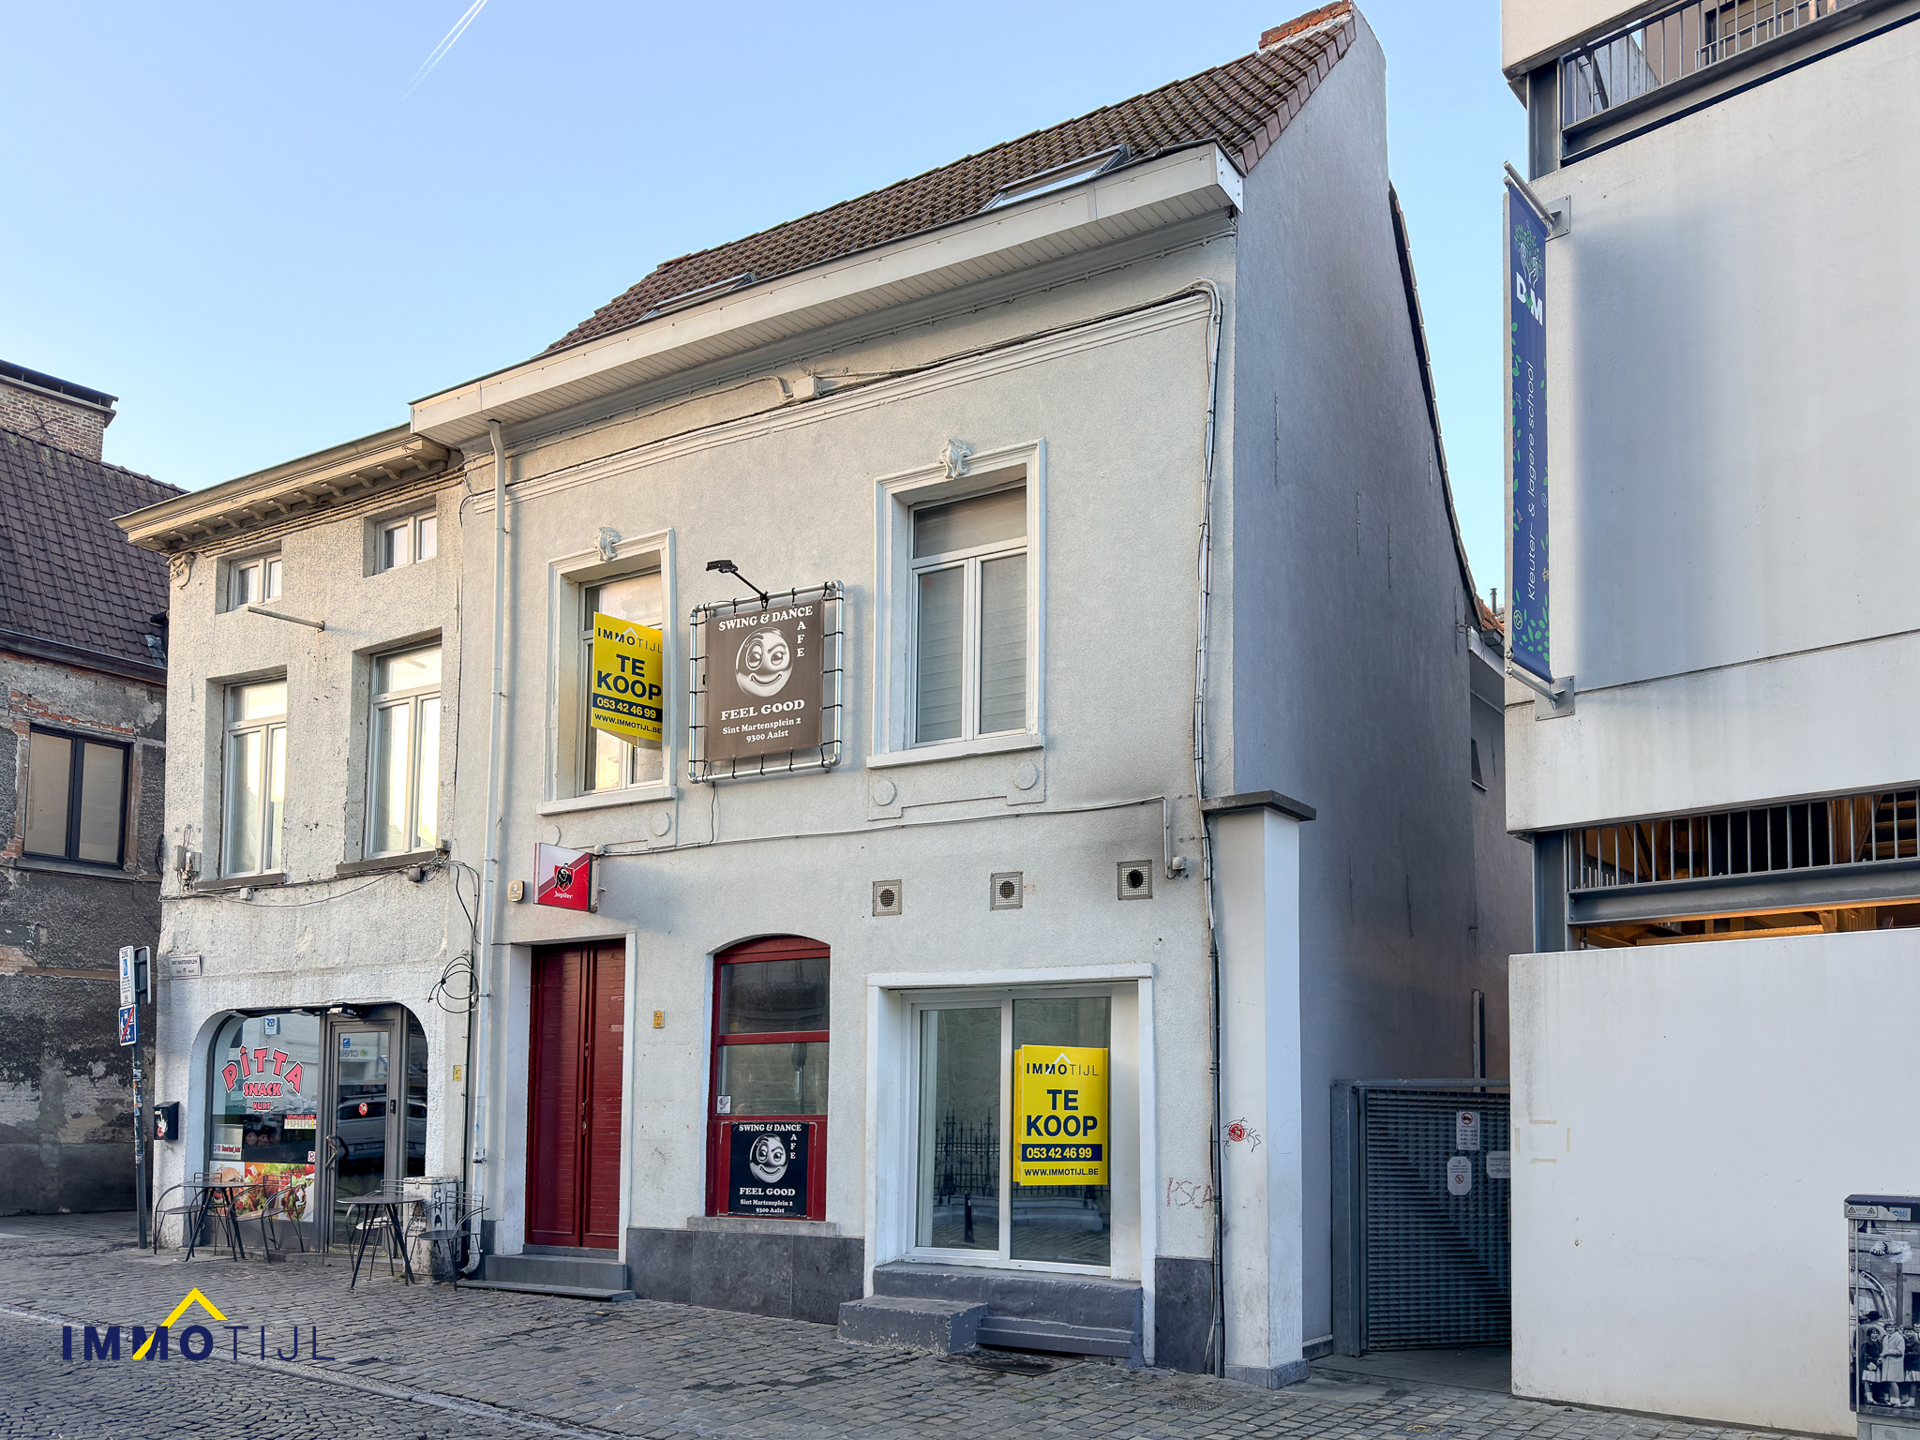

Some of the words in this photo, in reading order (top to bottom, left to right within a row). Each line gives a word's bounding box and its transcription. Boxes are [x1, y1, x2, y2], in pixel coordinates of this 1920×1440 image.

[1528, 435, 1537, 498] lagere
[1528, 502, 1536, 517] &
[1528, 523, 1536, 601] Kleuter-
[718, 615, 758, 632] SWING
[760, 613, 770, 624] &
[772, 605, 813, 623] DANCE
[598, 627, 662, 654] IMMOTIJL
[616, 653, 645, 678] TE
[597, 670, 662, 701] KOOP
[597, 697, 615, 709] 053
[617, 701, 629, 713] 42
[630, 704, 642, 716] 46
[644, 706, 656, 719] 99
[720, 706, 758, 721] FEEL
[760, 699, 806, 715] GOOD
[594, 713, 662, 734] WWW.IMMOTIJL.BE
[722, 725, 740, 735] Sint
[741, 718, 795, 733] Martensplein
[796, 717, 802, 725] 2
[746, 733, 765, 743] 9300
[767, 730, 789, 740] Aalst
[1026, 1063, 1099, 1077] IMMOTIJL
[243, 1081, 283, 1098] SNACK
[252, 1101, 272, 1111] KURT
[1046, 1089, 1079, 1111] TE
[738, 1124, 765, 1132] SWING
[766, 1124, 773, 1132] &
[774, 1124, 802, 1132] DANCE
[1026, 1115, 1098, 1137] KOOP
[1026, 1147, 1047, 1159] 053
[1048, 1147, 1062, 1159] 42
[1063, 1147, 1077, 1159] 46
[1078, 1147, 1092, 1159] 99
[1024, 1168, 1099, 1176] WWW.IMMOTIJL.BE
[739, 1187, 764, 1196] FEEL
[766, 1188, 796, 1196] GOOD
[752, 1199, 788, 1207] Martensplein
